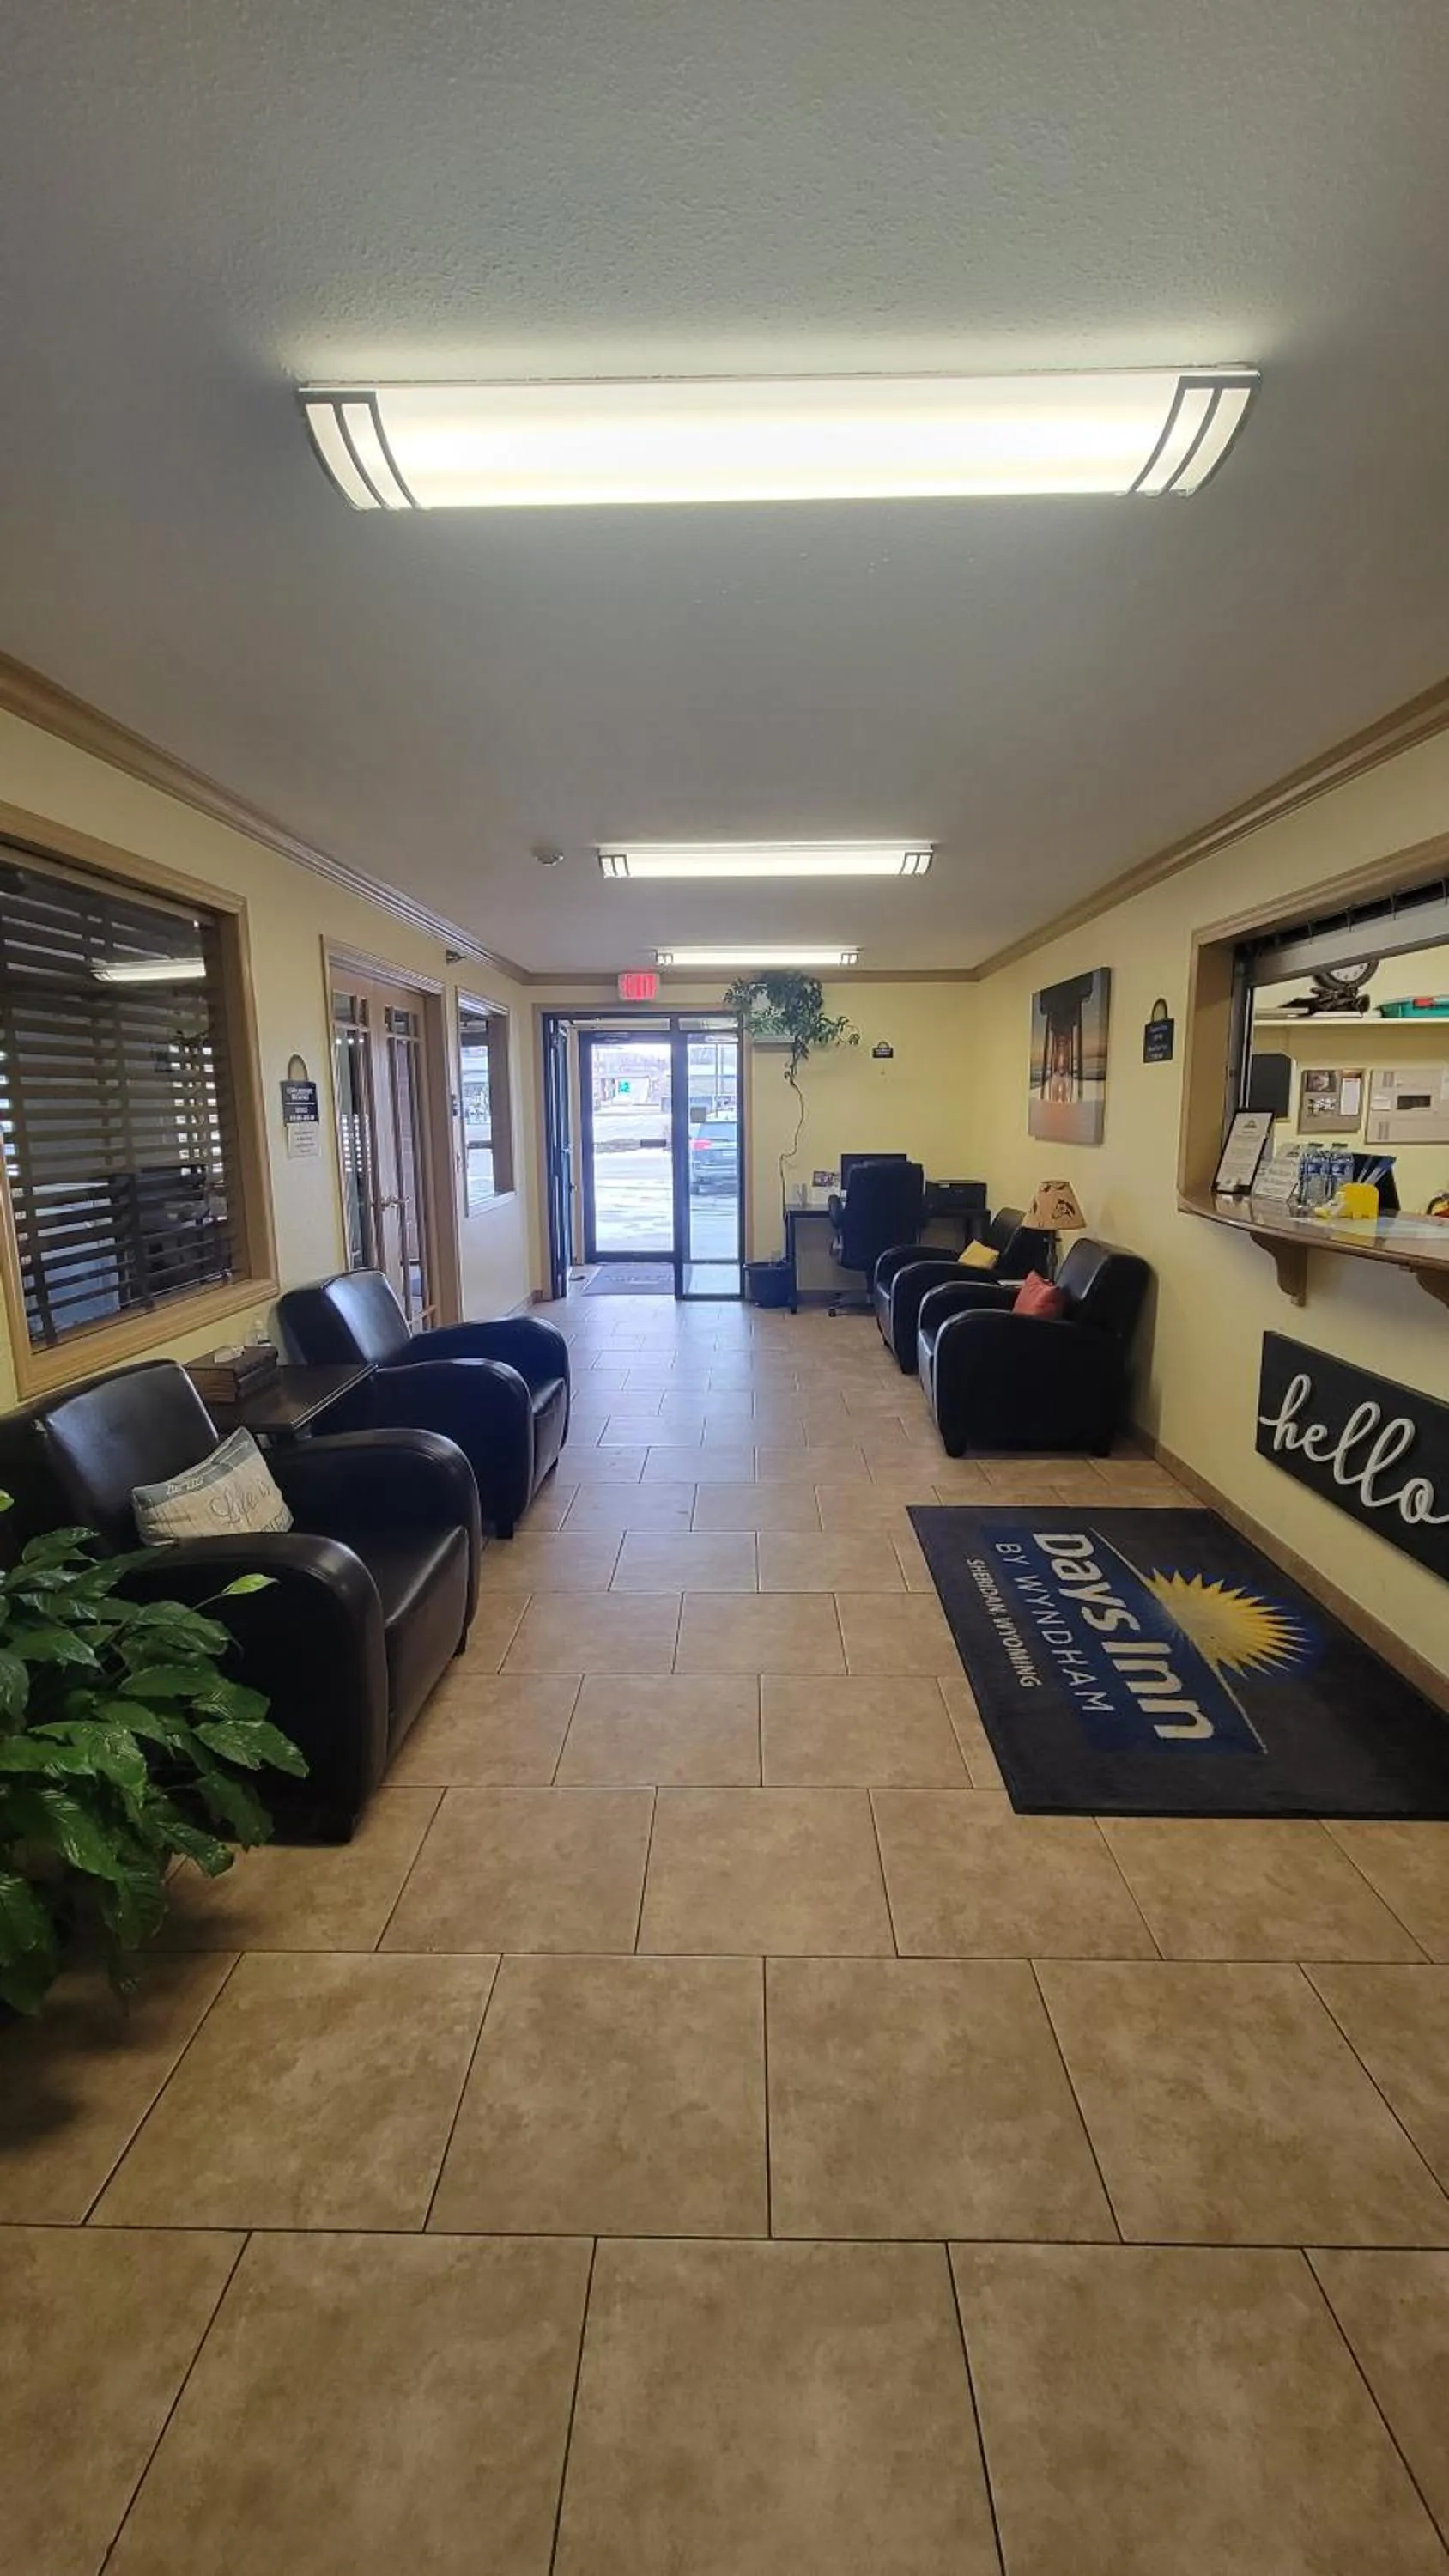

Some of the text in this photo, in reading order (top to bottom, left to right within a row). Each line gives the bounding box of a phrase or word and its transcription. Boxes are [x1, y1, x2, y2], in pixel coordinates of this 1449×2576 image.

[1259, 1373, 1449, 1524] hello
[967, 1558, 1043, 1688] SHERIDAN, WYOMING
[996, 1543, 1115, 1711] BY WYNDHAM
[1033, 1533, 1214, 1739] Days Inn
